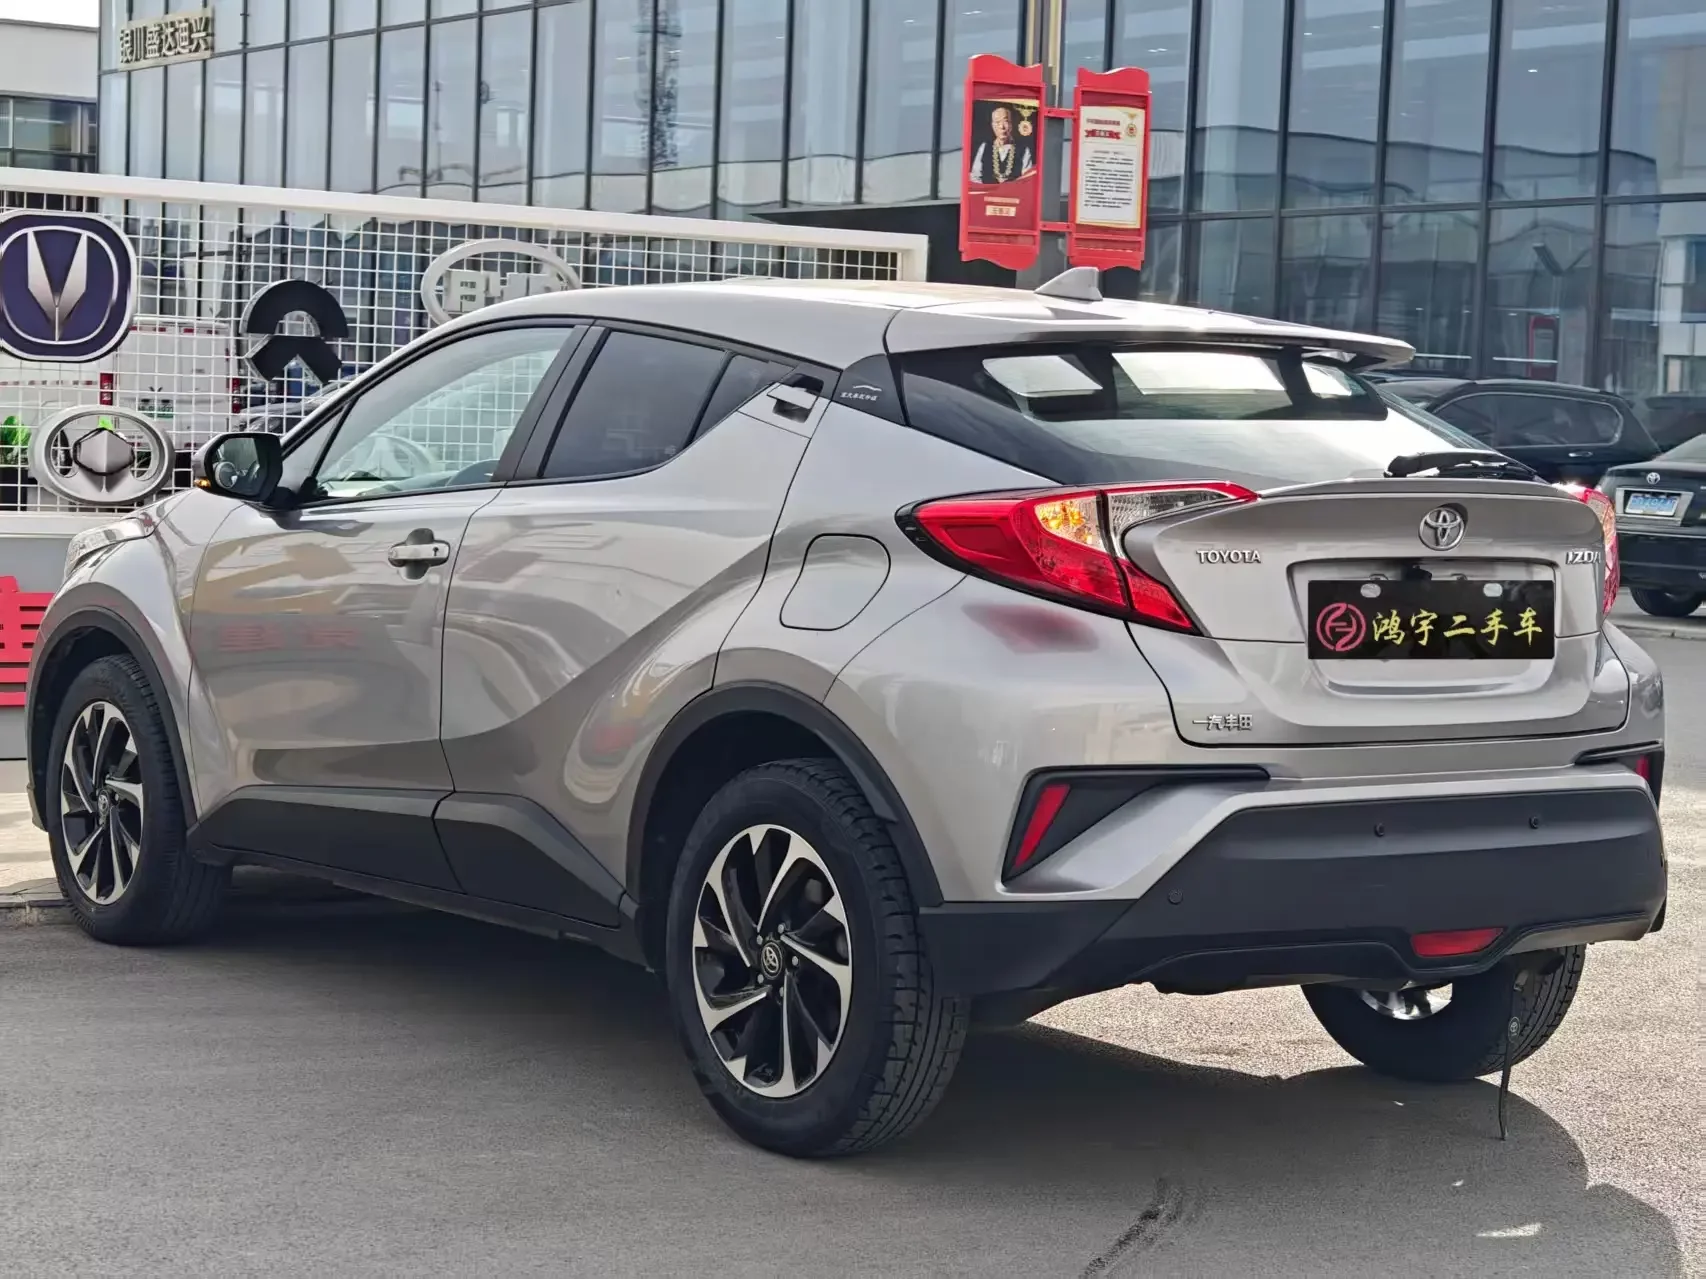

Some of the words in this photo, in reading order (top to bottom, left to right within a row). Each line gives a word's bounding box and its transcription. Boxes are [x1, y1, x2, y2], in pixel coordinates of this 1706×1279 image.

[1196, 549, 1261, 564] TOYOTA
[1371, 606, 1543, 646] 鸿宇二手车
[1192, 713, 1253, 731] 一汽丰田
